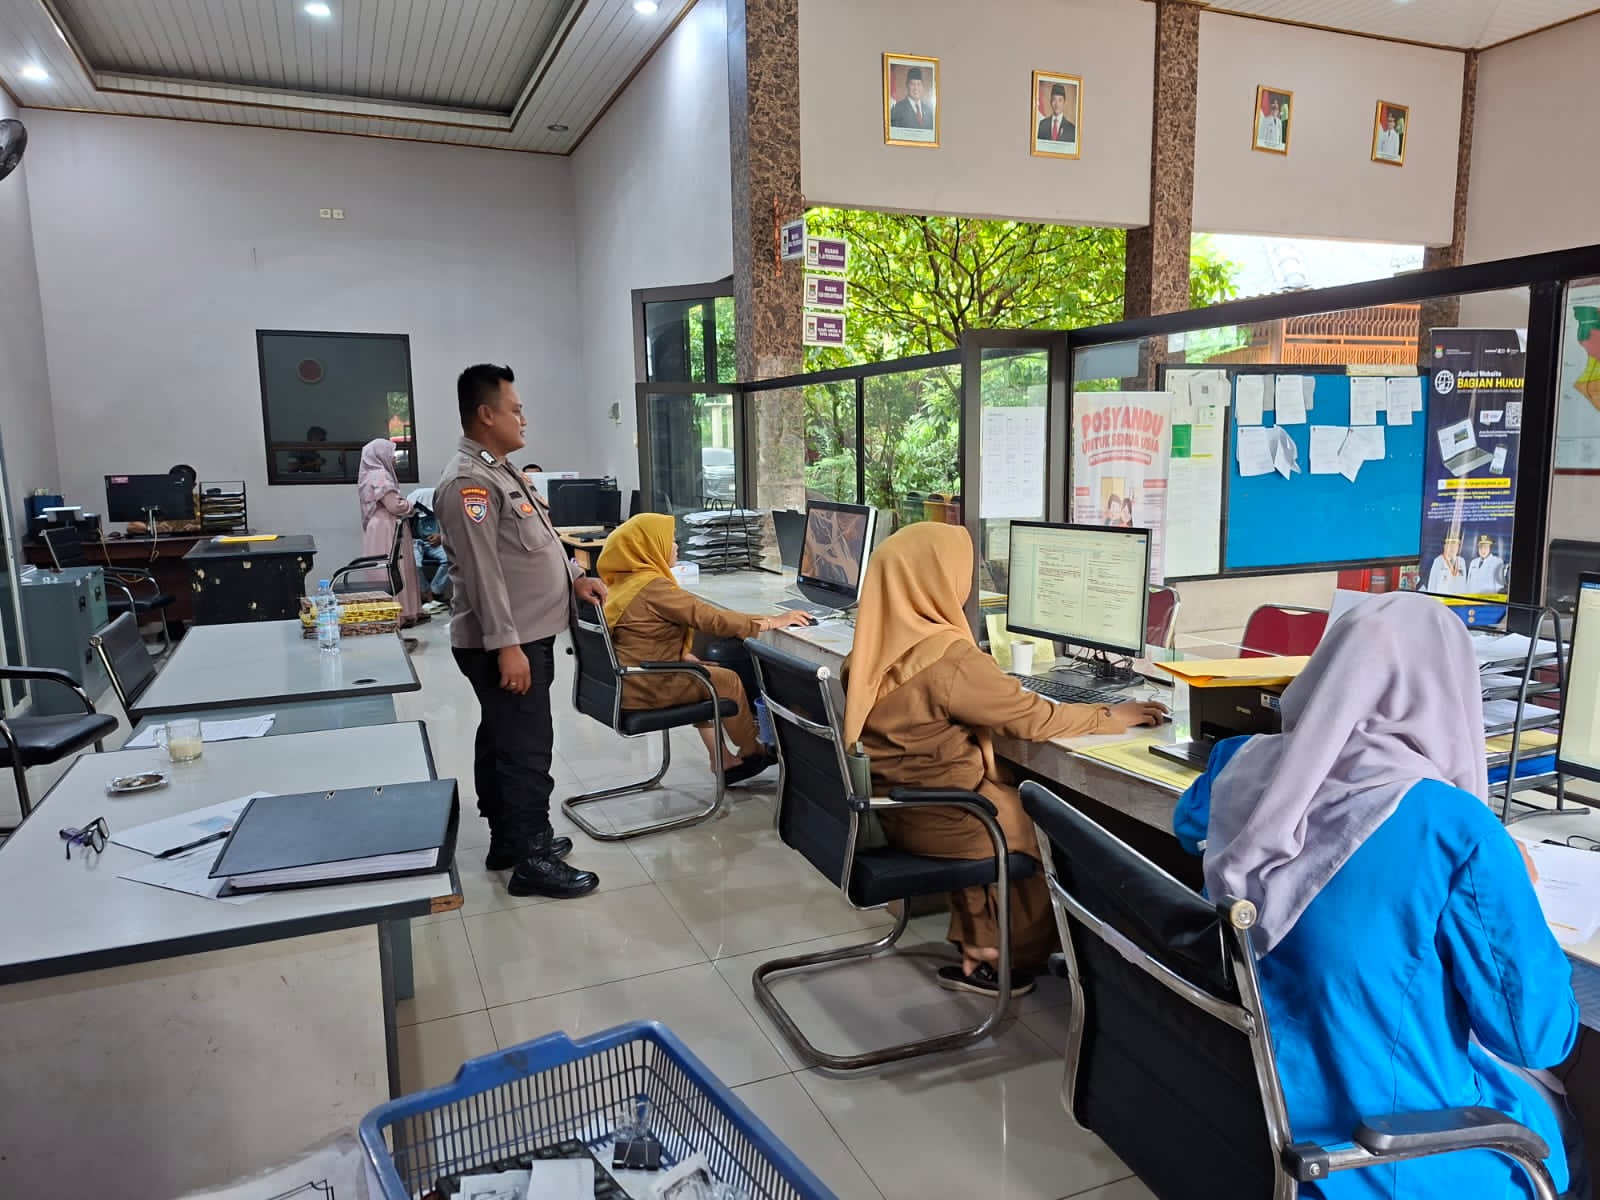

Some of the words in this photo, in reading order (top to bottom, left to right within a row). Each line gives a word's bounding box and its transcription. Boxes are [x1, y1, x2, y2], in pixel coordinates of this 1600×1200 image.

[1457, 377, 1494, 389] BAGIAN
[1082, 406, 1164, 439] POSYANDU
[1082, 434, 1109, 454] UNTUK
[1141, 438, 1159, 453] USIA
